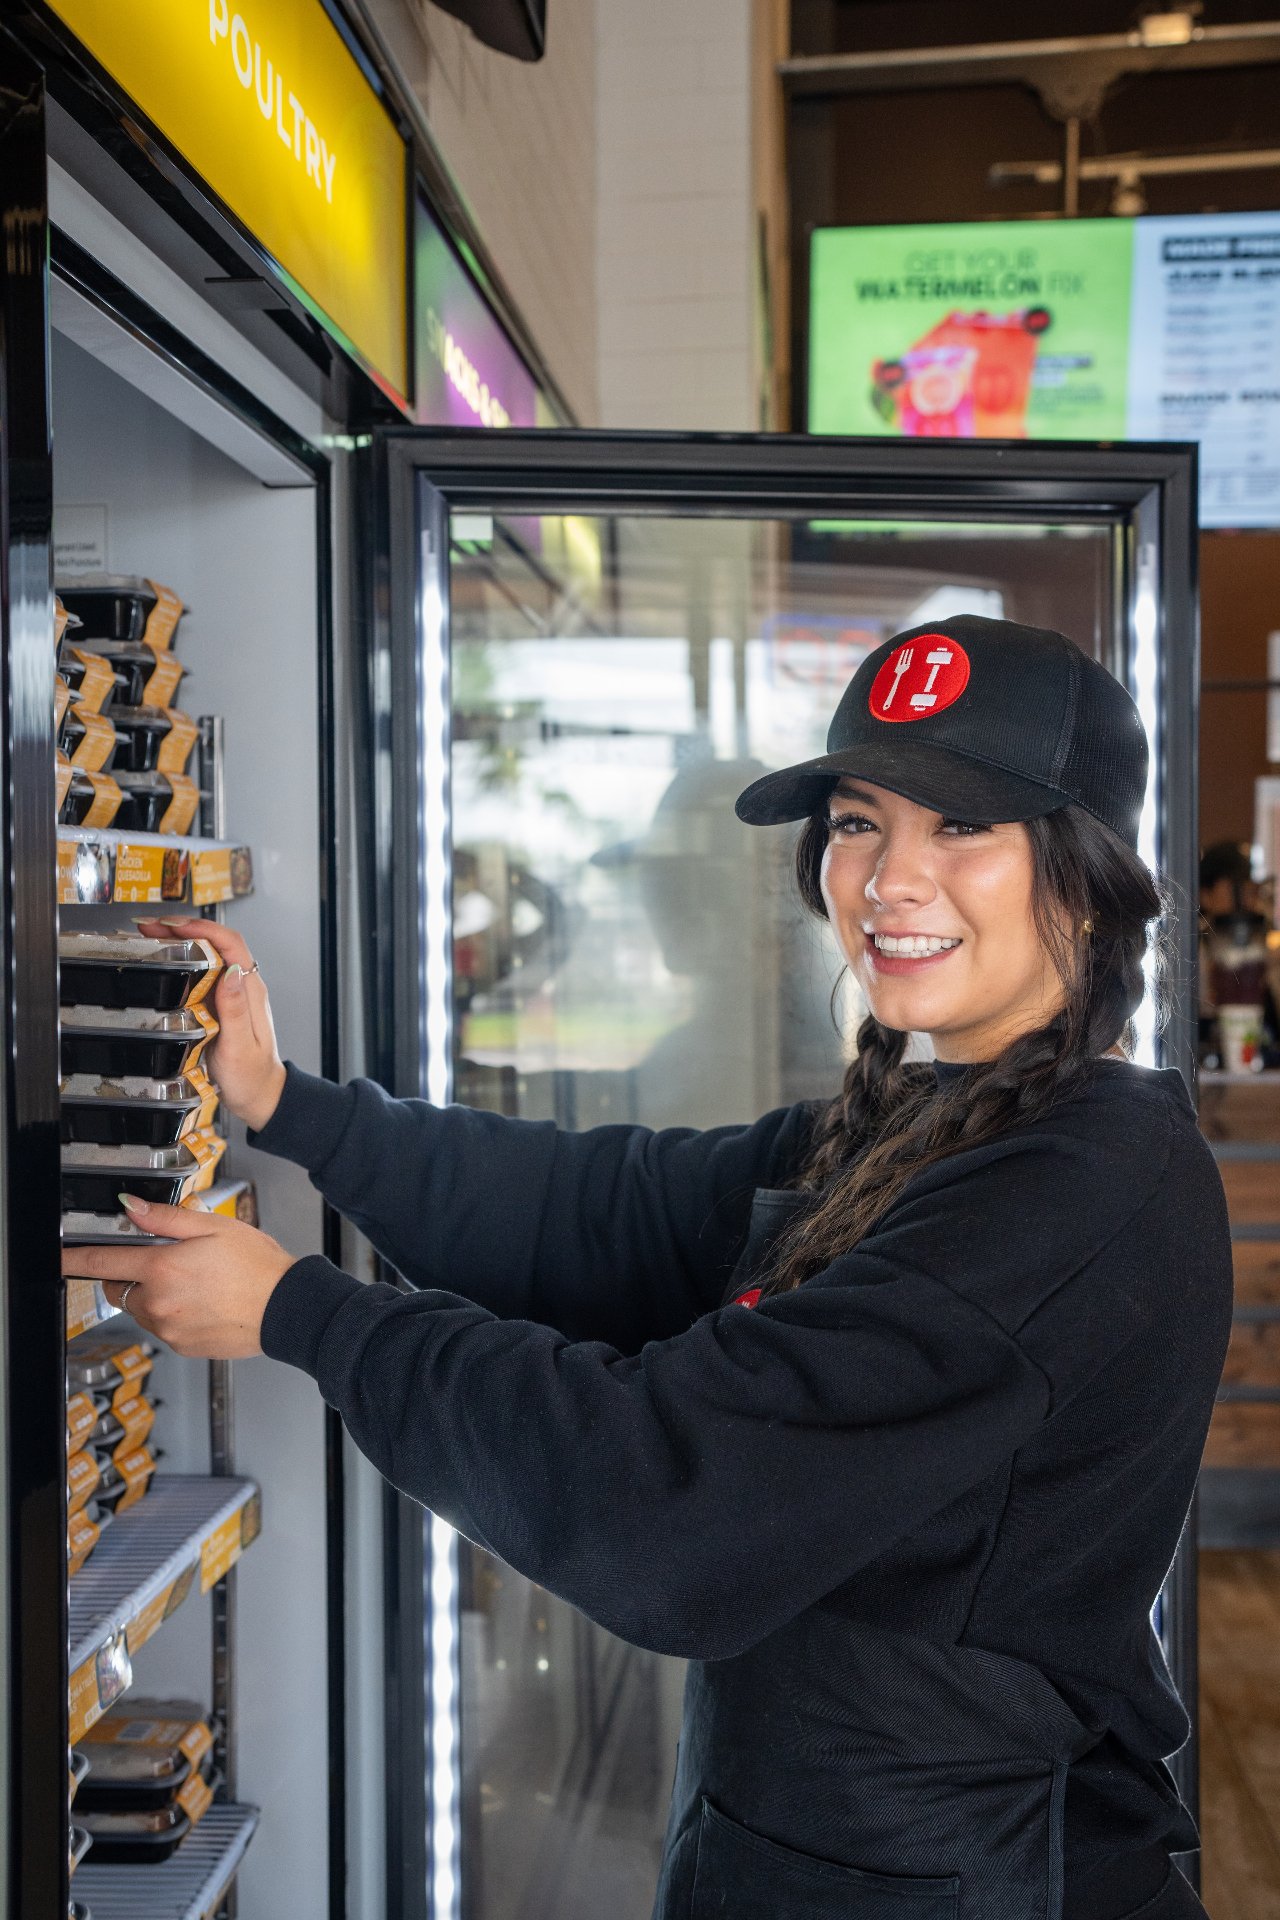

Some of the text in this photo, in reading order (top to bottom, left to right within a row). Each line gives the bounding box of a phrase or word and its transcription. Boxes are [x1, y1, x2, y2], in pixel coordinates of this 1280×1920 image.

[209, 0, 336, 204] POULTRY
[904, 246, 1040, 274] GET YOUR
[855, 272, 1042, 301] WATERMELON
[118, 857, 143, 868] CHICKEN
[117, 871, 151, 883] QUESADILLA
